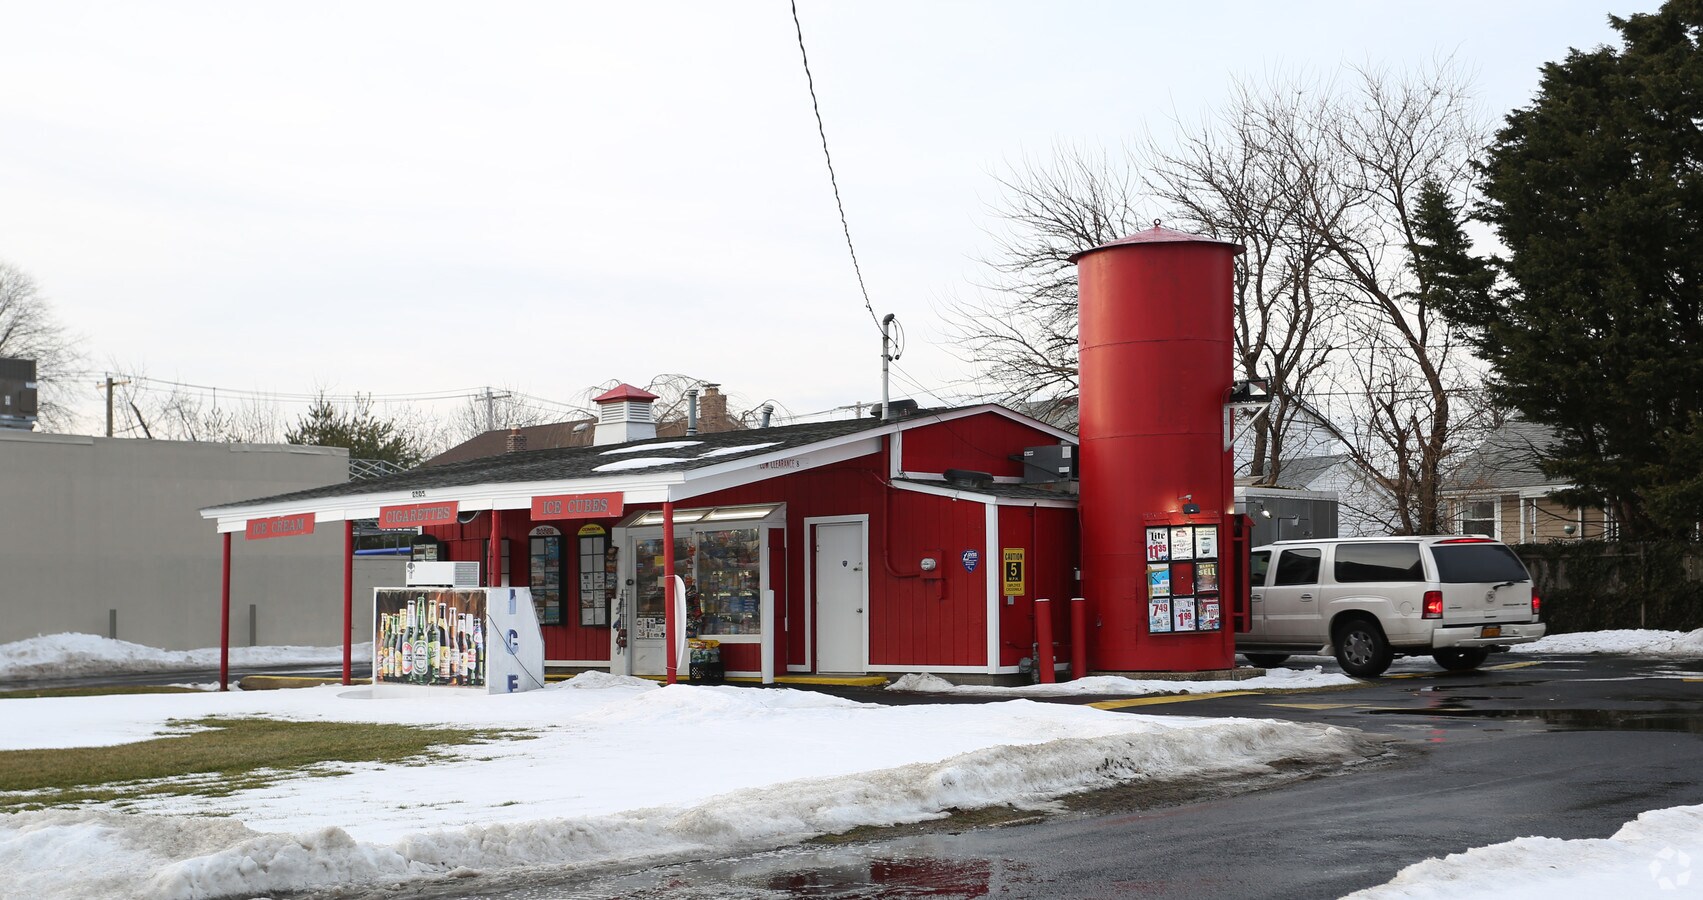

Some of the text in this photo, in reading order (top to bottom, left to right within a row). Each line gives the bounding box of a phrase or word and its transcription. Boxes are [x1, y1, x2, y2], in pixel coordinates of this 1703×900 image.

[543, 498, 608, 514] ICE CUBES
[385, 506, 450, 523] CIGARETTES
[253, 518, 304, 535] ICE CREAM
[1151, 532, 1166, 541] Lite
[1010, 563, 1017, 576] 5
[1198, 568, 1216, 576] SELL
